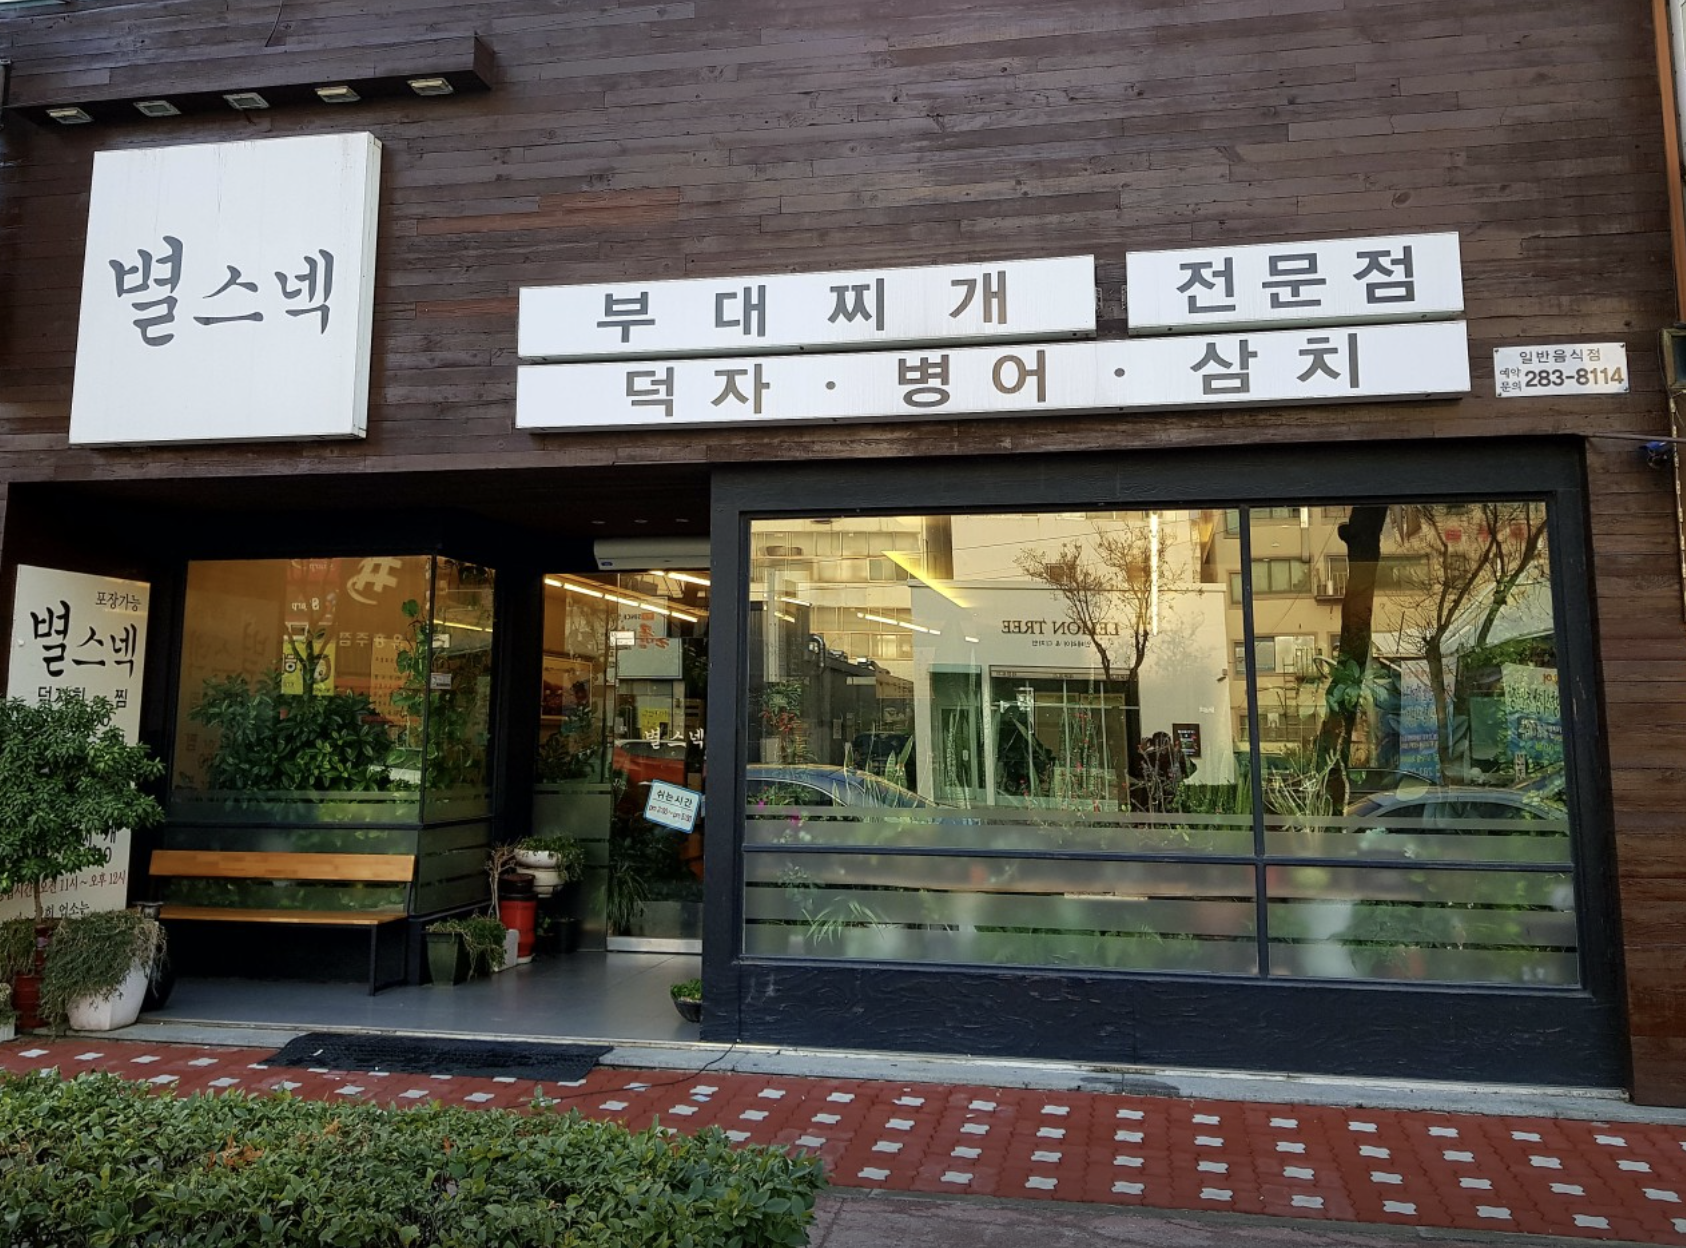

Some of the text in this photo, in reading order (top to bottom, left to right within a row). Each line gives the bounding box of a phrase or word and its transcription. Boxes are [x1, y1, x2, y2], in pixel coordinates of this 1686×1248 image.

[1176, 244, 1417, 314] 전문점
[108, 235, 335, 347] 별스넥
[596, 270, 1008, 343] 부대찌개
[1519, 347, 1601, 364] 일반음식점
[1500, 367, 1521, 379] 예약
[1524, 366, 1624, 388] 283-8114
[1500, 381, 1522, 392] 문의
[96, 591, 141, 612] 포장가능
[30, 600, 137, 678] 별스넥
[114, 688, 128, 709] 찜
[645, 726, 704, 750] 별스넥
[60, 874, 78, 890] 11시
[89, 872, 107, 887] 오후
[109, 869, 126, 885] 12시
